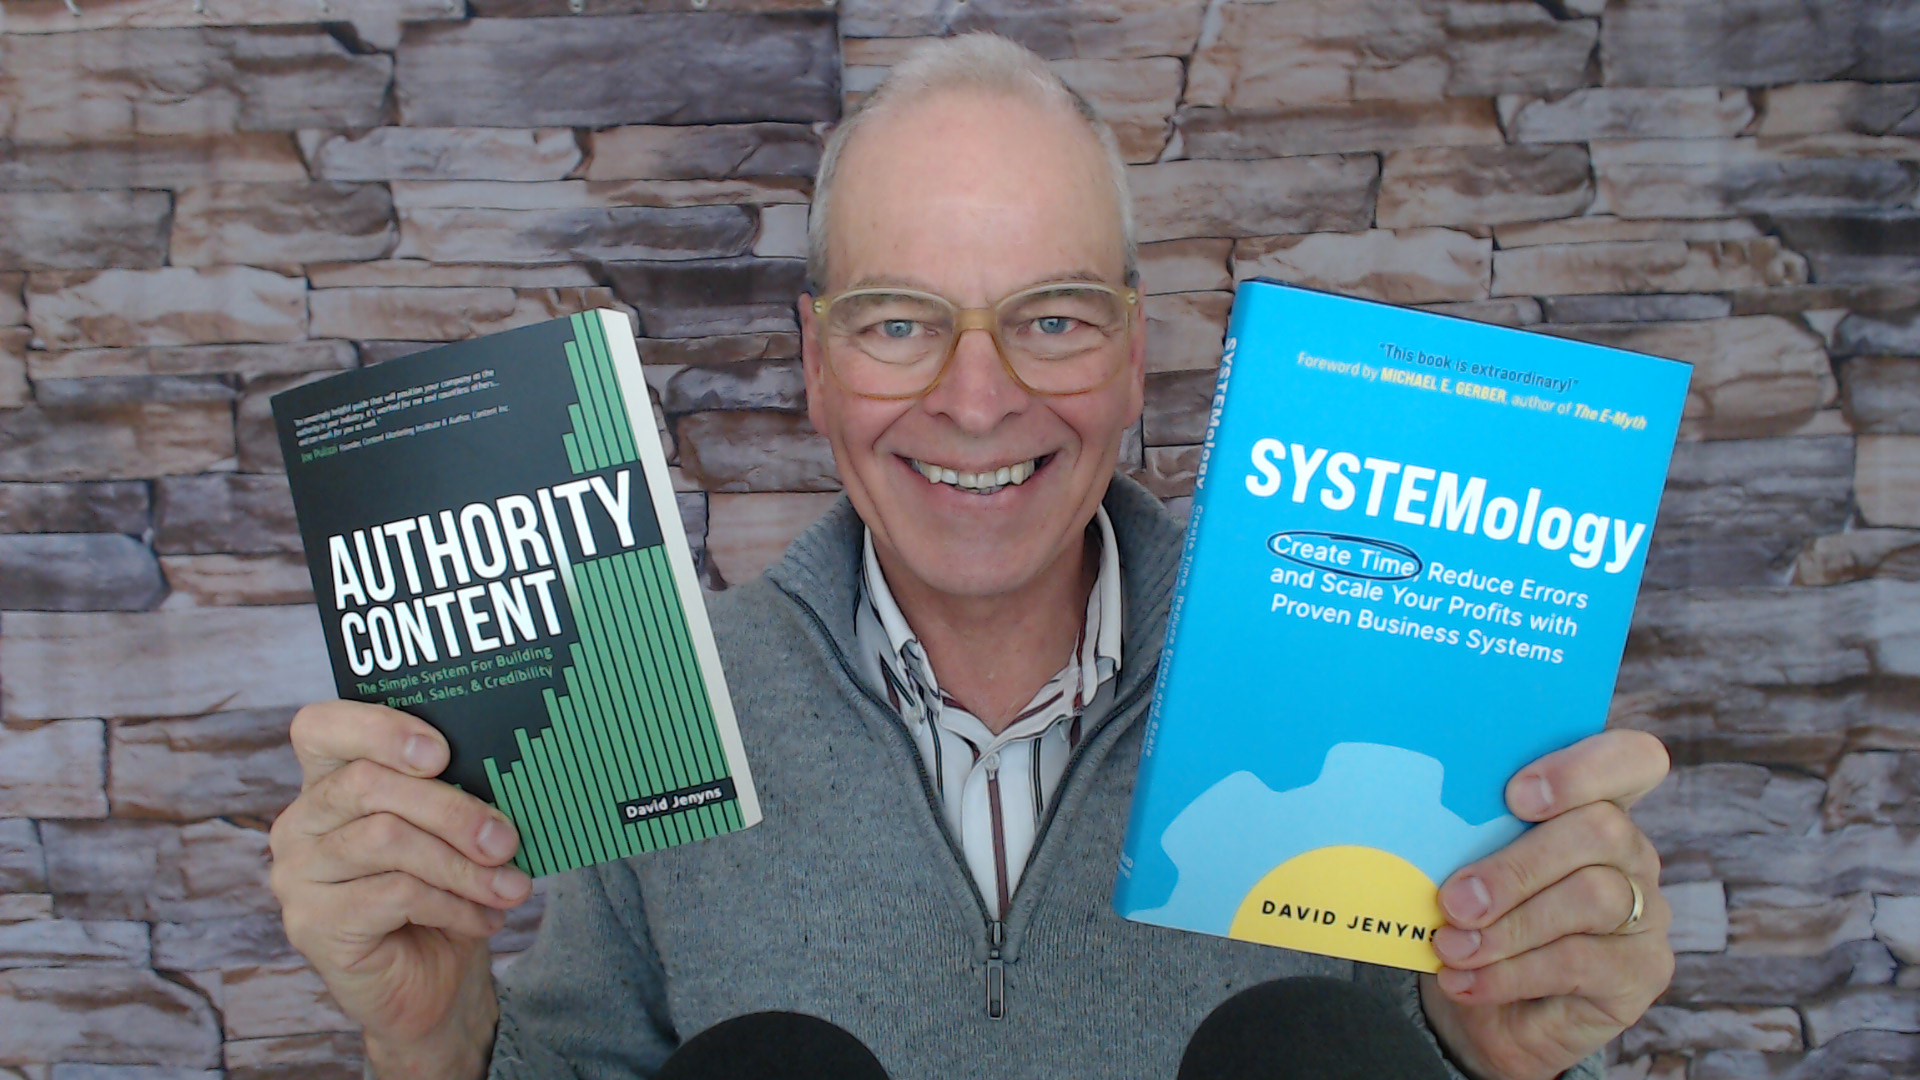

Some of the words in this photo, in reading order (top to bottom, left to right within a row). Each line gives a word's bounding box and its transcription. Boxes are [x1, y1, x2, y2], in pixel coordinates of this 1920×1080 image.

[1297, 351, 1360, 377] Foreword
[1362, 365, 1379, 382] by
[1380, 366, 1437, 391] MICHAEL
[1440, 377, 1451, 393] E.
[1511, 394, 1555, 412] author
[1557, 401, 1573, 416] of
[1574, 403, 1598, 421] The
[1599, 408, 1648, 430] E-Myth
[1379, 342, 1413, 363] "This
[1417, 350, 1451, 369] book
[1455, 358, 1467, 373] is
[1471, 362, 1580, 393] extraordinary!"
[1197, 336, 1238, 489] SYSTEMology
[328, 469, 636, 611] AUTHORITY
[1245, 437, 1647, 575] SYSTEMology
[1269, 566, 1316, 590] and
[1320, 572, 1384, 602] Scale
[1392, 583, 1444, 613] Your
[1447, 594, 1524, 628] Profits
[1529, 612, 1579, 638] with
[1272, 534, 1352, 566] Create
[1427, 561, 1515, 596] Reduce
[1519, 577, 1590, 610] Errors
[340, 568, 562, 677] CONTENT
[1270, 592, 1352, 626] Proven
[1356, 608, 1461, 646] Business
[1465, 628, 1565, 665] Systems
[355, 681, 377, 697] The
[378, 673, 420, 693] Simple
[421, 665, 469, 685] System
[471, 659, 494, 674] For
[495, 645, 555, 668] Building
[429, 683, 469, 701] Sales,
[470, 679, 483, 693] &
[484, 664, 555, 689] Credibility
[625, 796, 669, 819] David
[671, 785, 723, 809] Jenyns
[1261, 899, 1337, 926] DAVID
